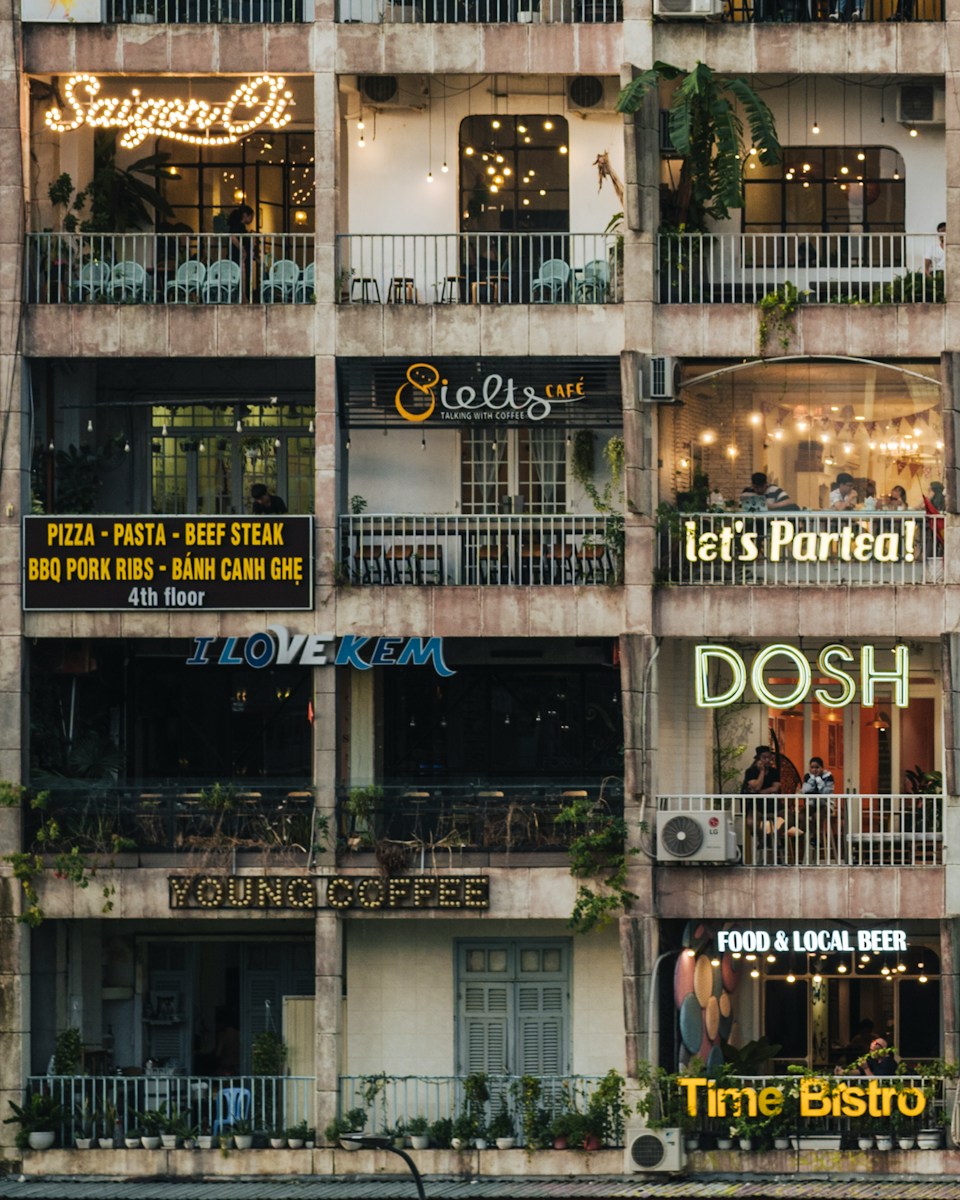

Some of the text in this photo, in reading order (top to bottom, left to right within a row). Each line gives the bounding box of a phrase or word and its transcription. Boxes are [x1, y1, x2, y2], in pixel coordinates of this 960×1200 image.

[441, 412, 524, 420] TALKING WITH COFFEE
[47, 523, 95, 546] PIZZA
[113, 523, 166, 546] PASTA
[185, 522, 226, 546] BEEF
[230, 522, 284, 546] STEAK
[769, 520, 916, 562] Partea!
[28, 557, 61, 583] BBQ
[66, 557, 111, 580] PORK
[116, 557, 154, 580] RIBS
[172, 552, 216, 580] BÁNH
[220, 557, 266, 580] CANH
[270, 556, 303, 586] GHẸ
[128, 587, 206, 606] 4th floor
[186, 624, 457, 678] I LOVE KEM
[695, 643, 909, 708] DOSH
[169, 877, 488, 908] YOUNG COFFEE
[718, 930, 907, 952] FOOD & LOCAL BEER
[678, 1078, 927, 1117] Time Bistro
